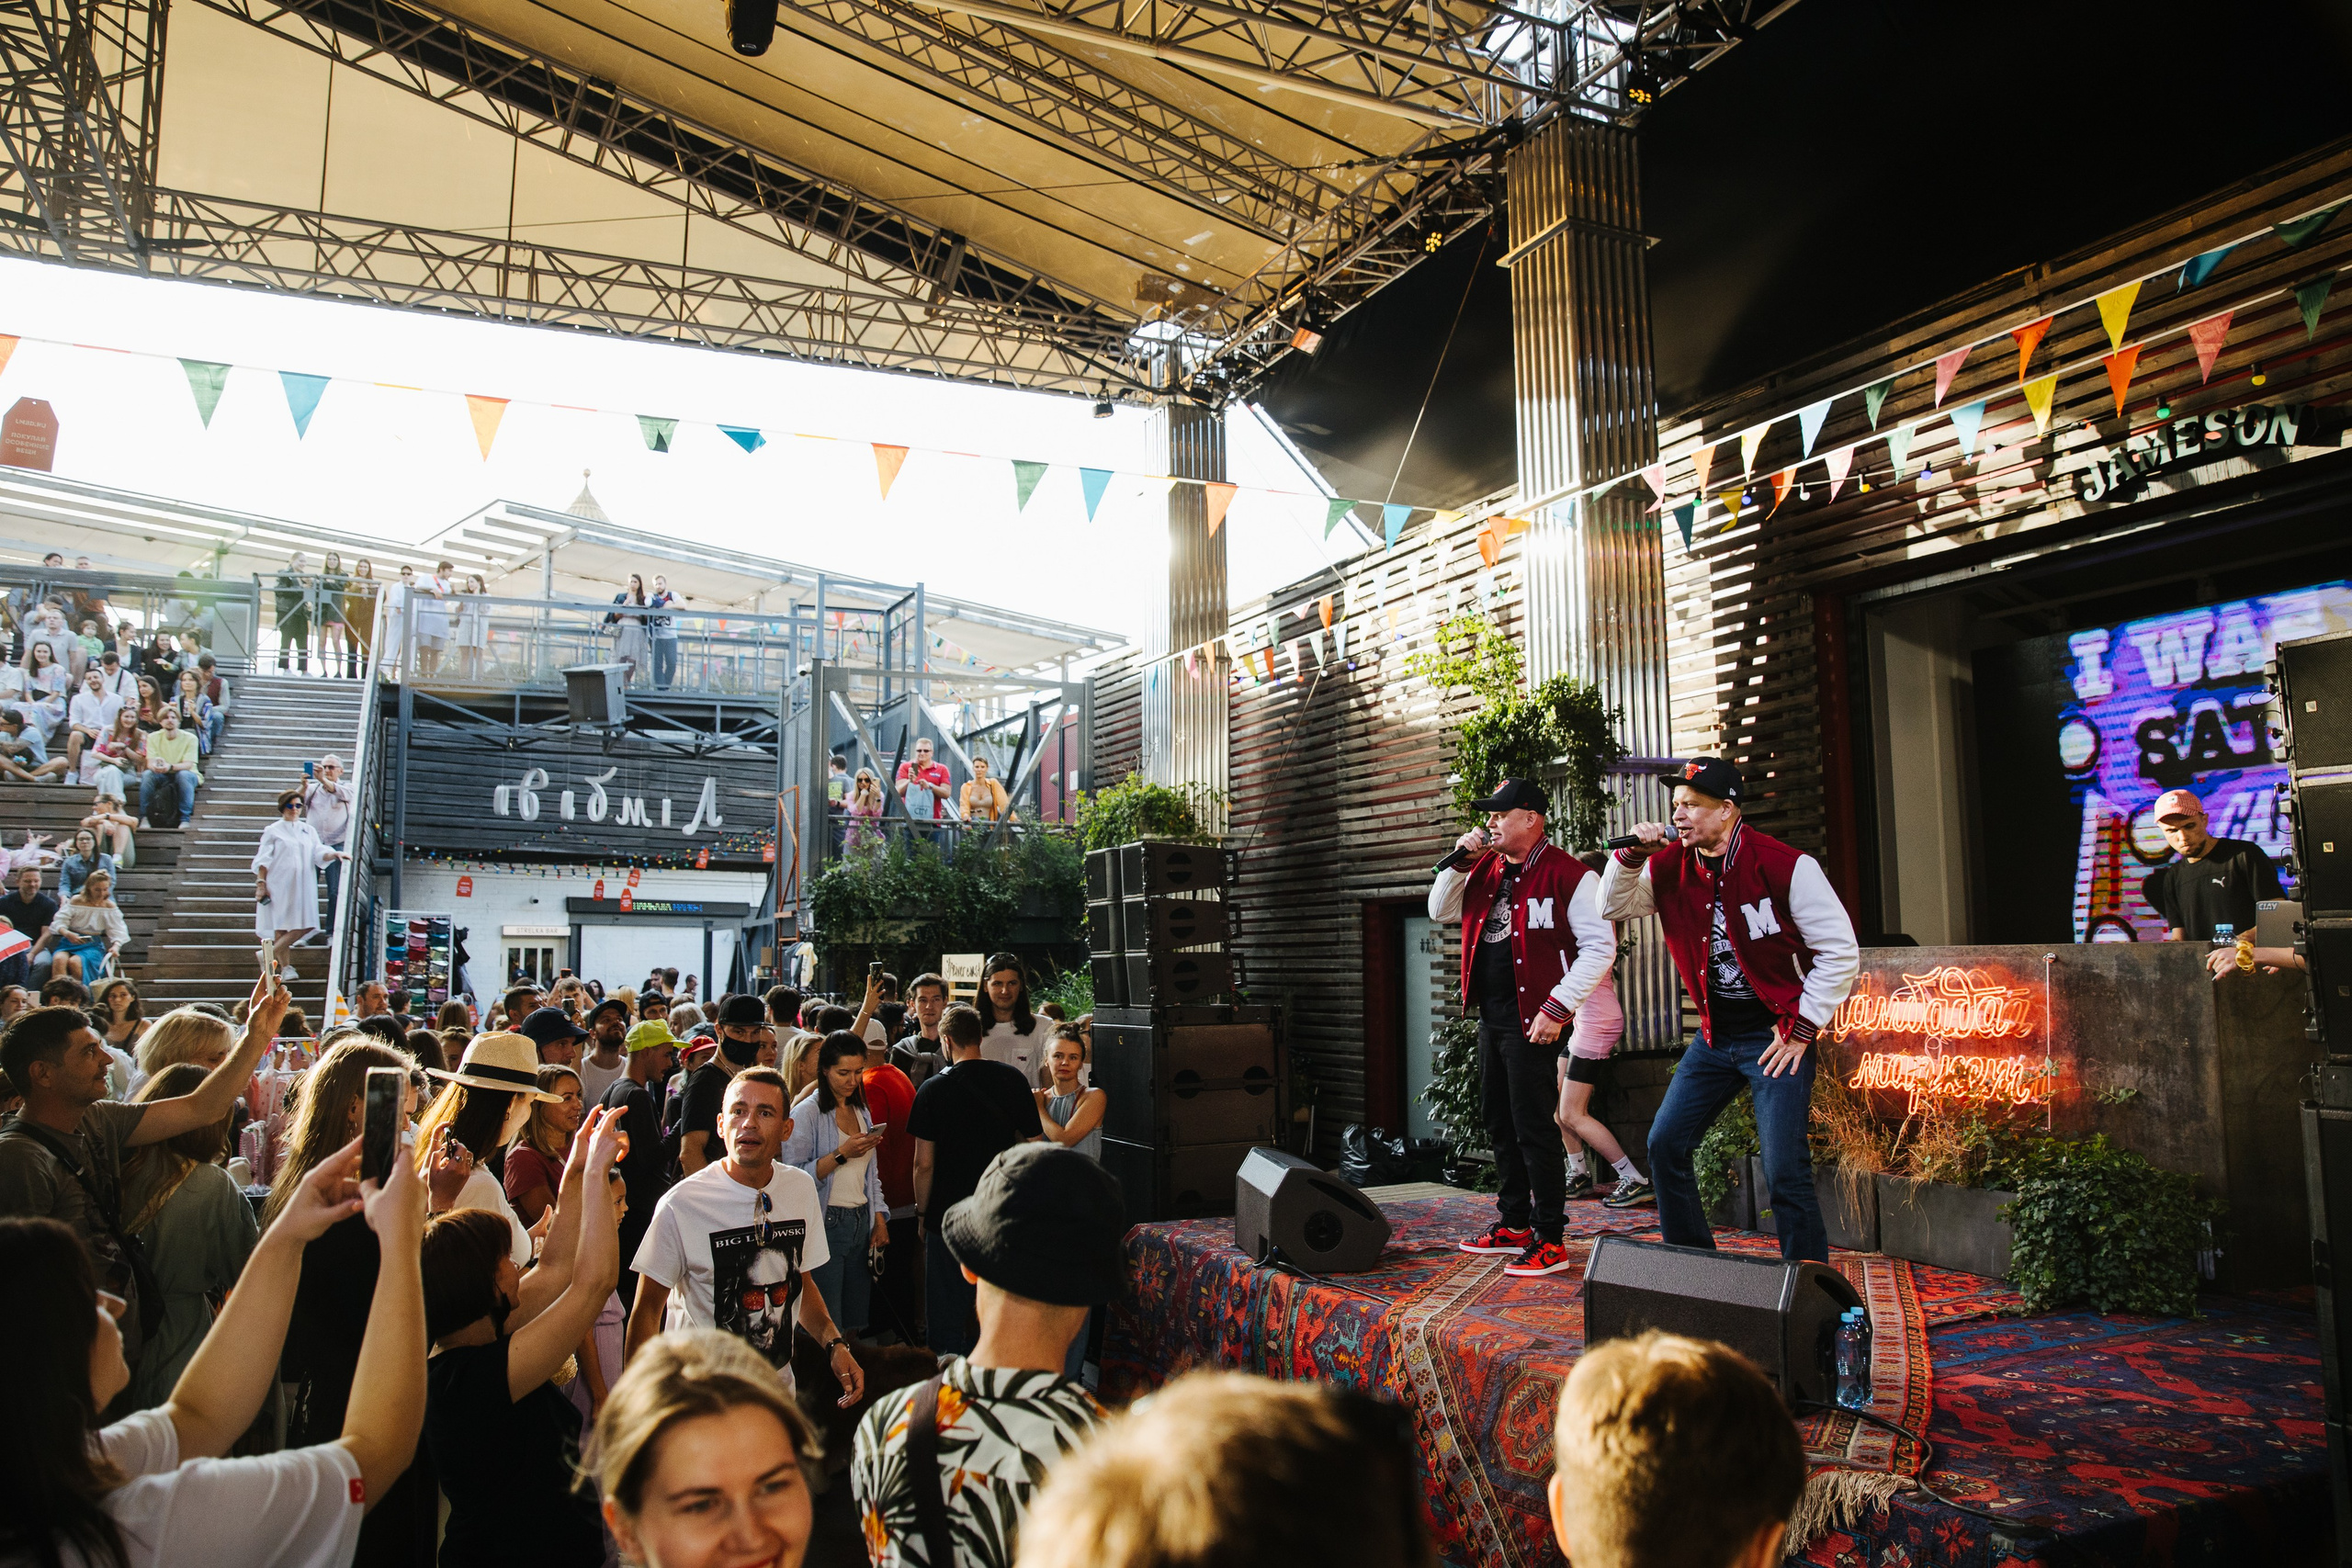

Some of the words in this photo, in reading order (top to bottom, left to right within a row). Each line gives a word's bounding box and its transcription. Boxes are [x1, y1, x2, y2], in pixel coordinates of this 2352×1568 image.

[2083, 403, 2306, 502] JAMESON
[1527, 897, 1555, 930] M
[1740, 897, 1781, 941] M
[715, 1236, 742, 1249] BIG
[746, 1227, 805, 1243] LOWSKI
